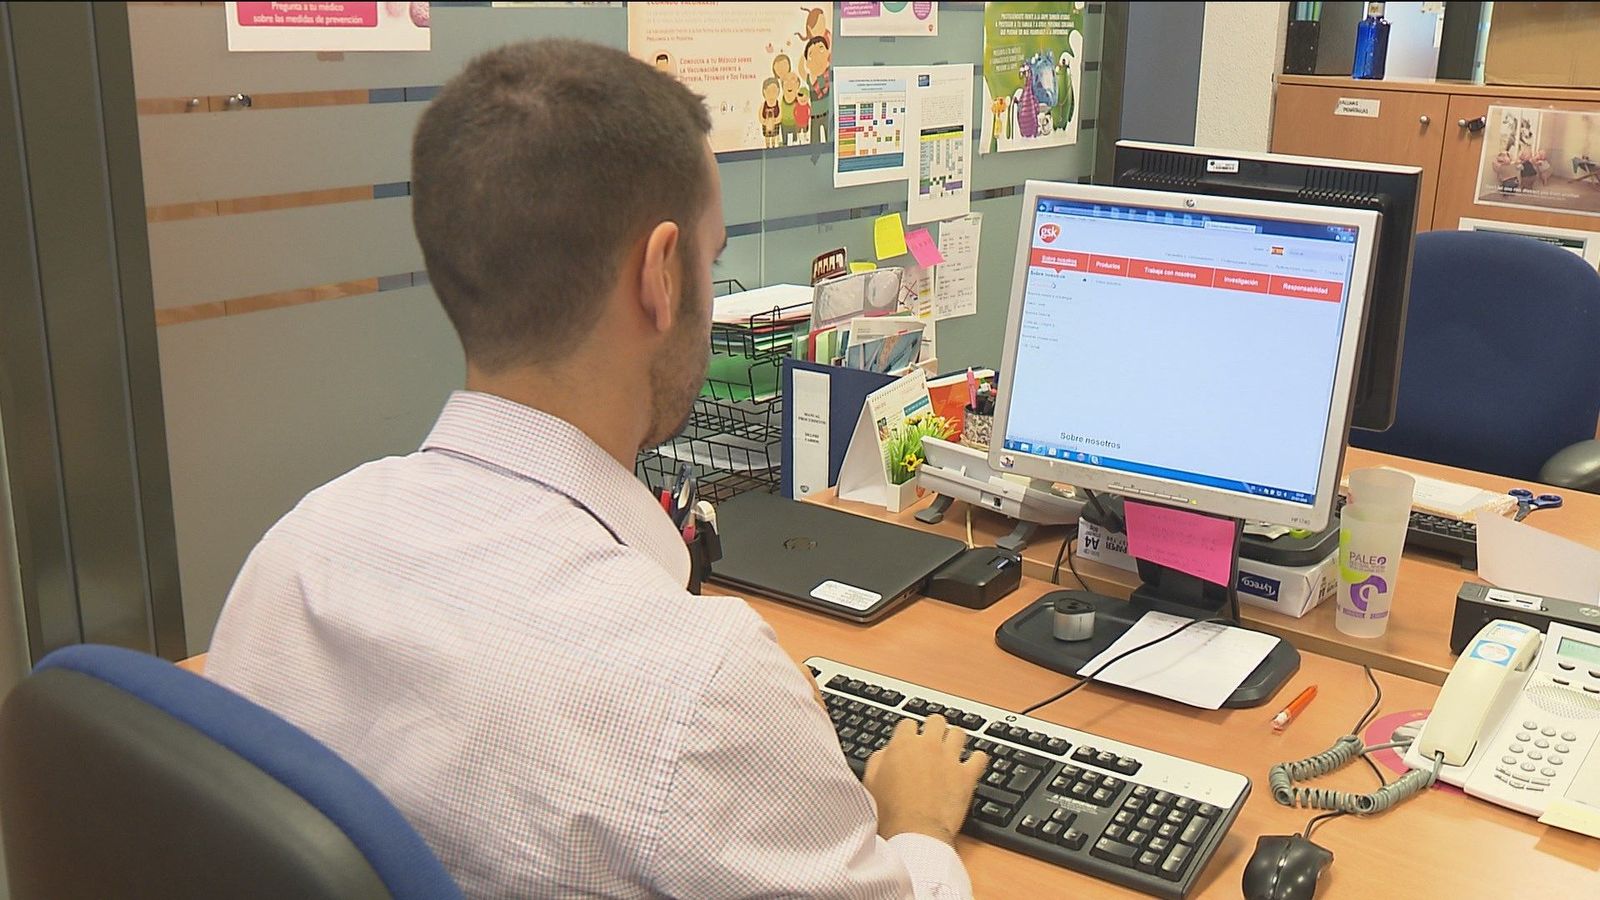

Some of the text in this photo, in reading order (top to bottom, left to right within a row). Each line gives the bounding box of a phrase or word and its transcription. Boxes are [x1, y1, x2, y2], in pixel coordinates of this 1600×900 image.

[253, 14, 273, 23] sobre
[285, 14, 315, 24] medidas
[325, 15, 364, 26] prevención
[1040, 226, 1058, 239] gsk
[1095, 260, 1121, 270] Productos
[1174, 271, 1197, 279] nosotros
[1224, 276, 1259, 287] Investigación
[1283, 282, 1329, 295] Responsabilidad
[1060, 432, 1121, 449] Sobre nosotros
[1085, 536, 1100, 550] A4
[1243, 579, 1273, 595] Lyreco
